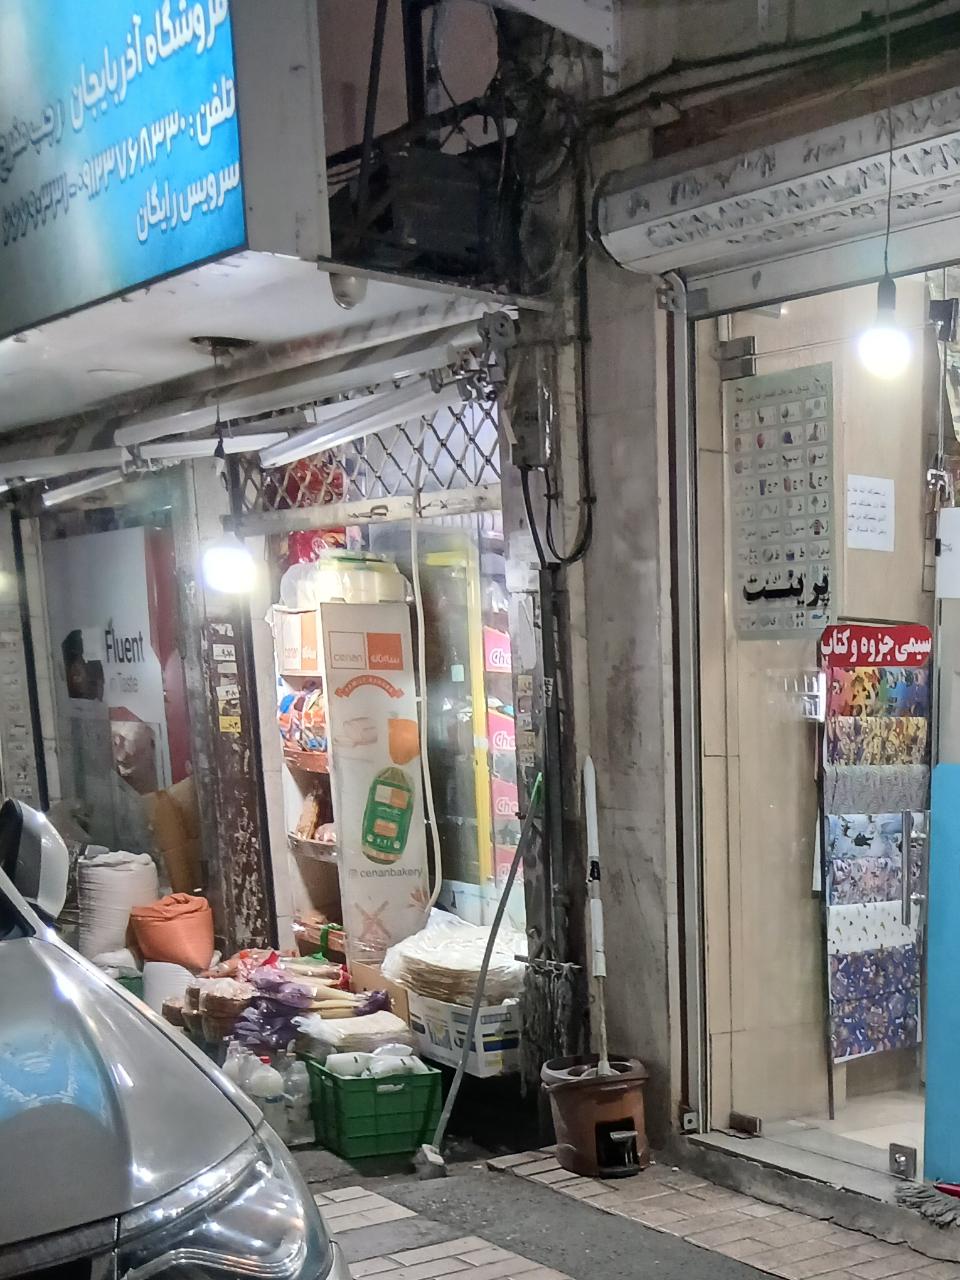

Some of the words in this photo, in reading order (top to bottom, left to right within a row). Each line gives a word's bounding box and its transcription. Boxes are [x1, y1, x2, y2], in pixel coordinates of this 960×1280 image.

[71, 14, 142, 131] آذربایجان
[180, 162, 240, 222] سرویس
[137, 181, 178, 242] رایگان
[105, 629, 145, 663] Fluent
[821, 628, 850, 664] کتاب
[849, 639, 858, 662] و
[861, 633, 895, 662] جزوه
[895, 637, 932, 662] سیمی
[360, 867, 423, 878] cenanbakery
